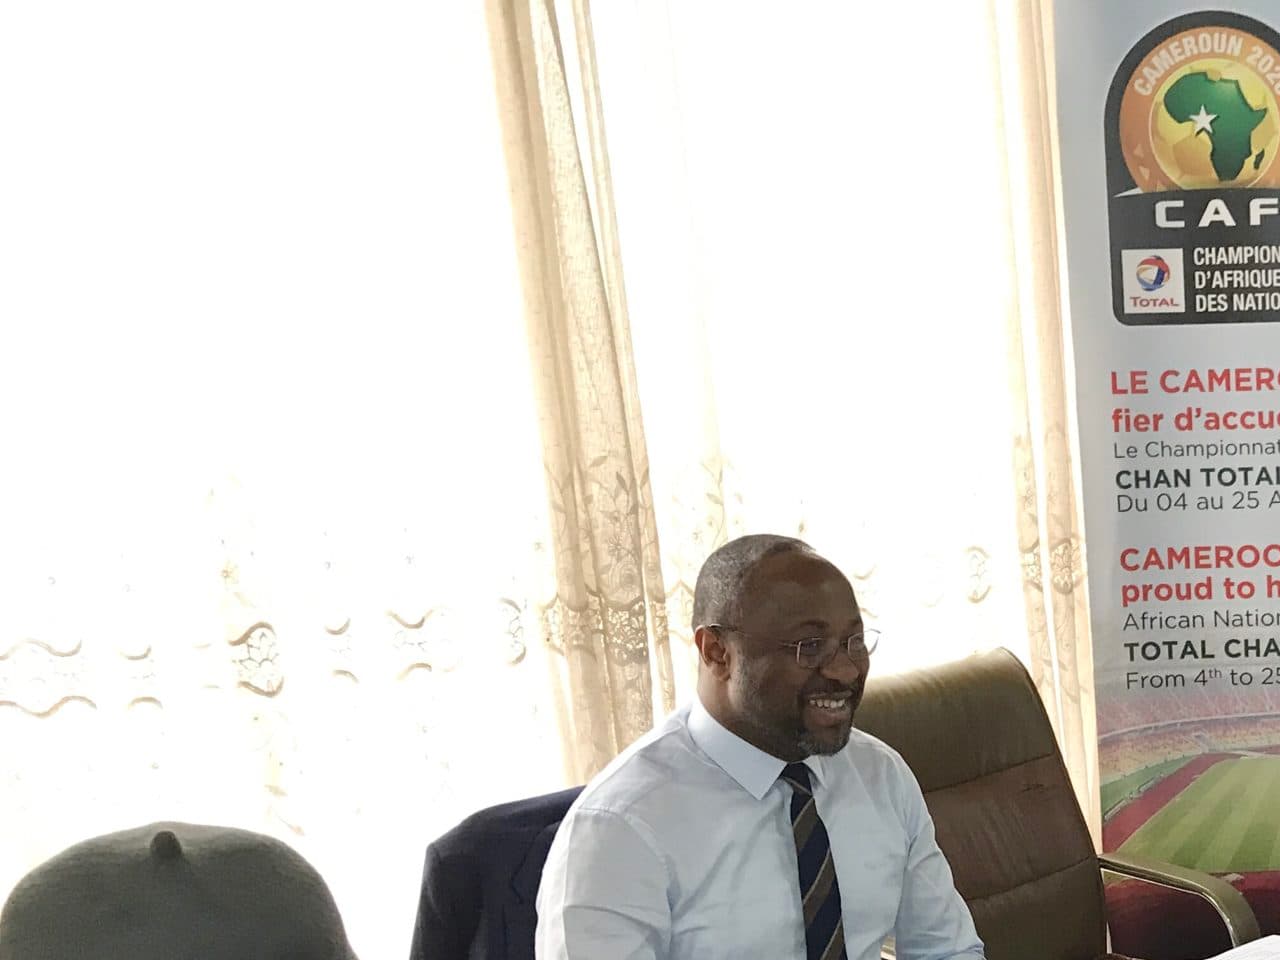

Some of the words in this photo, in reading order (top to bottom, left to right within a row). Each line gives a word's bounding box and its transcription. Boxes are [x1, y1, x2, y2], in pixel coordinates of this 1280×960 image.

[1134, 33, 1244, 96] CAMEROUN
[1155, 198, 1280, 228] CAF
[1195, 294, 1229, 313] DES
[1111, 371, 1148, 395] LE
[1112, 408, 1163, 433] fier
[1114, 442, 1138, 459] Le
[1116, 468, 1191, 490] CHAN
[1117, 493, 1149, 513] Du
[1157, 493, 1188, 511] 04
[1197, 494, 1224, 511] au
[1232, 491, 1259, 509] 25
[1121, 577, 1212, 607] proud
[1224, 578, 1256, 599] to
[1123, 609, 1204, 630] African
[1124, 641, 1215, 661] TOTAL
[1126, 671, 1183, 689] From
[1193, 669, 1222, 687] 4th
[1229, 668, 1253, 686] to
